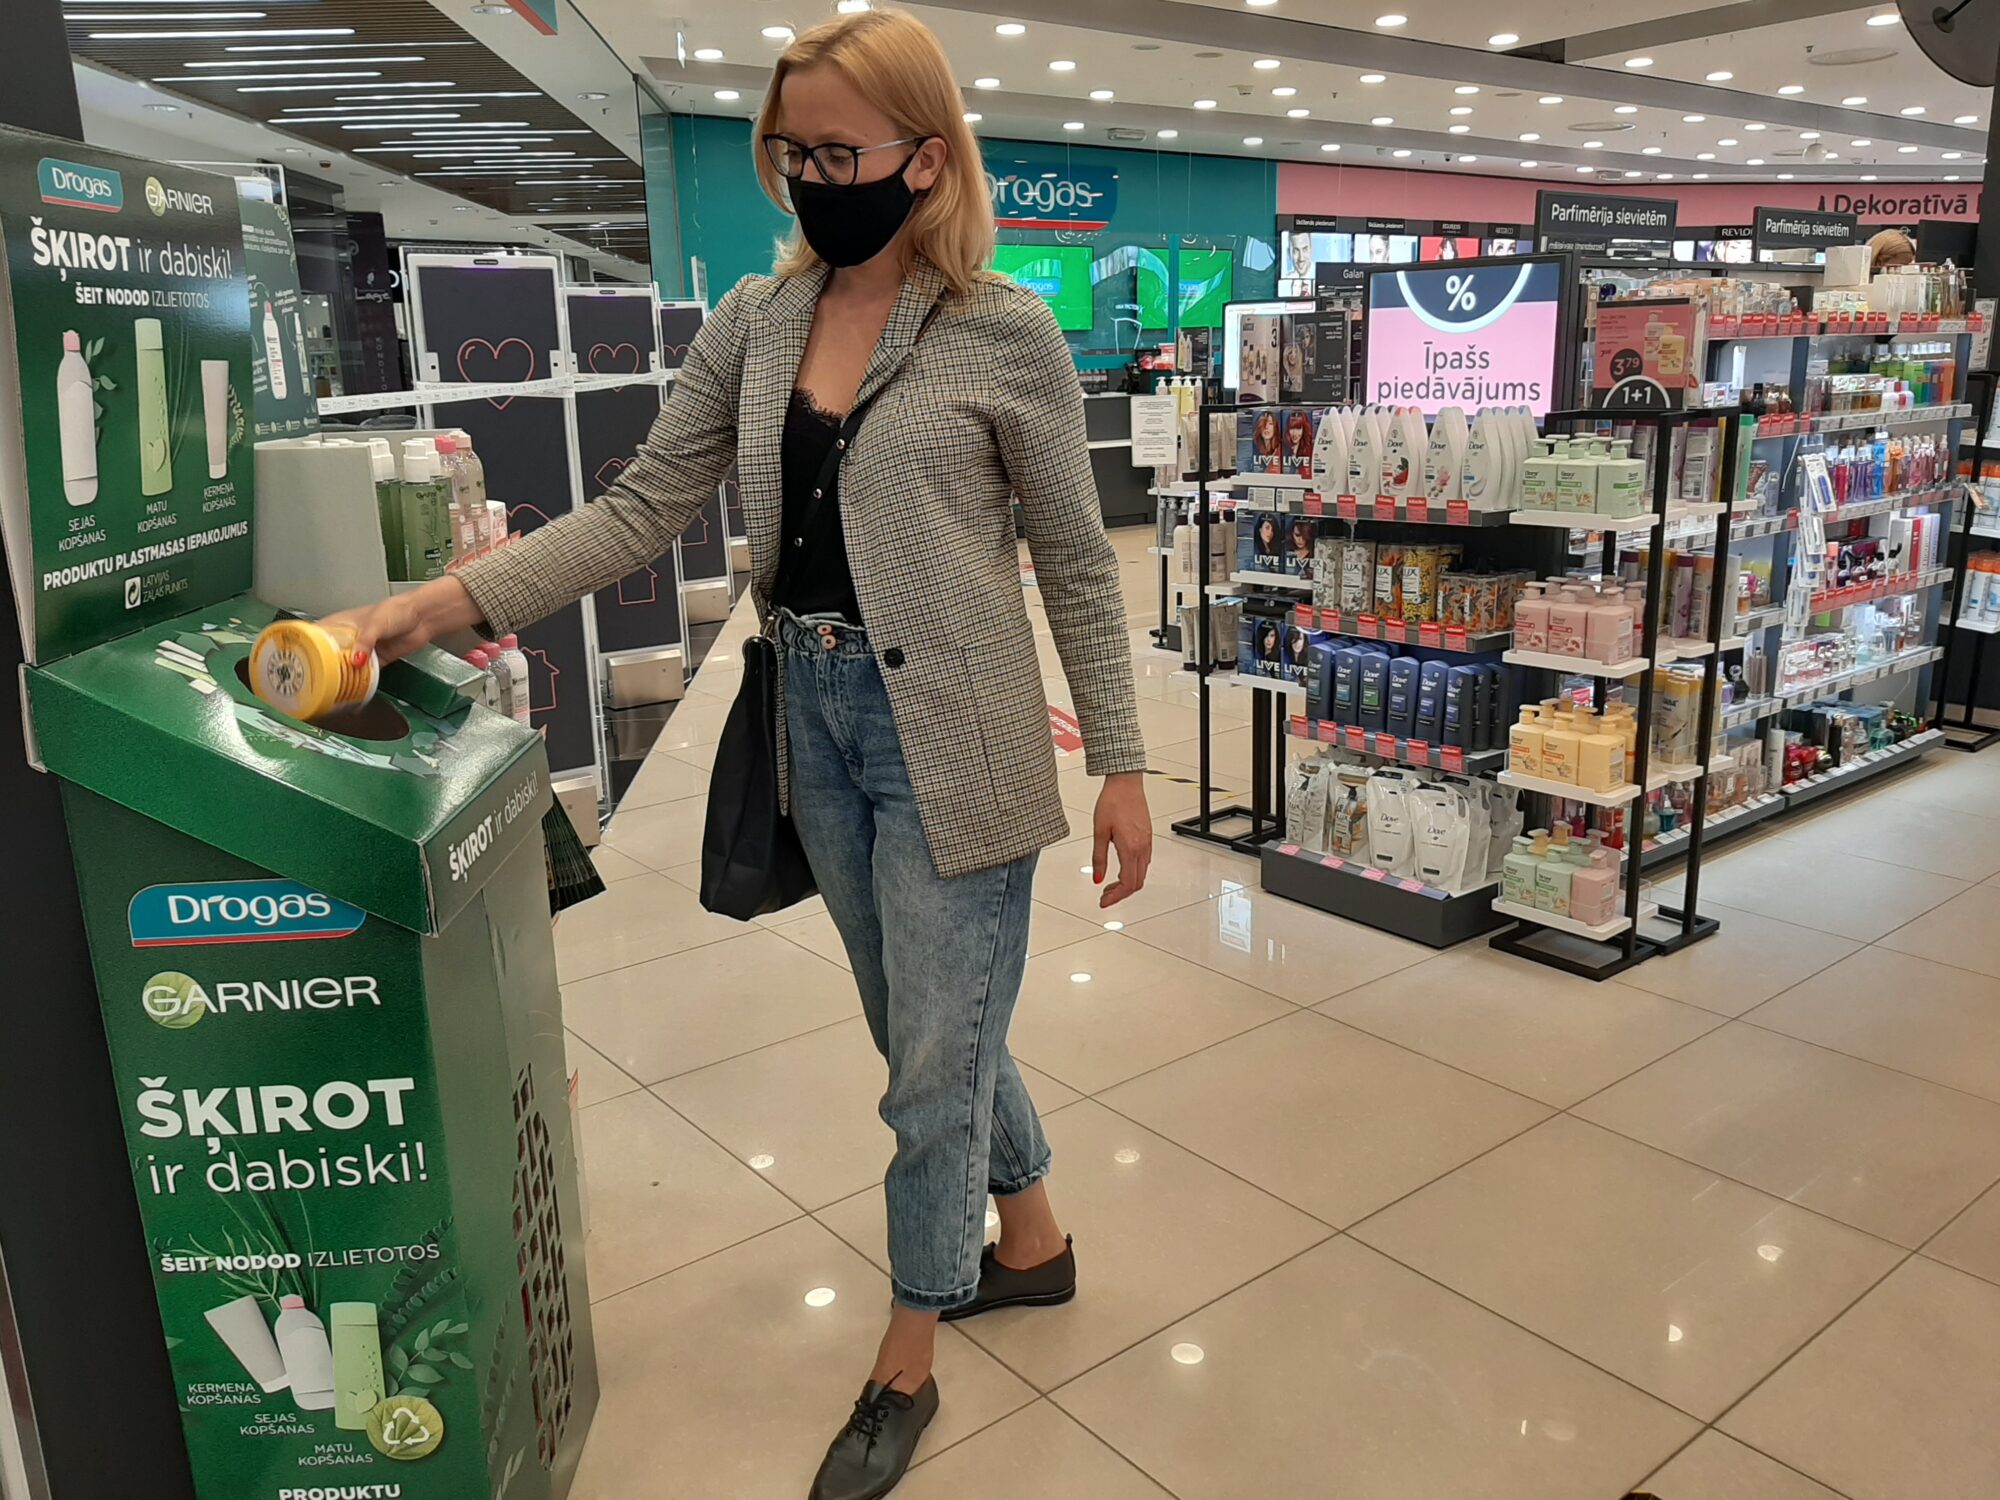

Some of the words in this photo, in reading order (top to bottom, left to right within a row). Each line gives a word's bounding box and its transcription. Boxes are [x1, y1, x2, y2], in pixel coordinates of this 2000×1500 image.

[52, 167, 112, 198] Drogas
[1834, 194, 1968, 215] Dekoratīvā
[1551, 203, 1613, 226] Parfimērija
[1615, 208, 1667, 226] sievietēm
[1721, 228, 1753, 238] REVLO
[1765, 218, 1810, 237] Parfimērija
[1811, 222, 1849, 238] sievietēm
[30, 216, 131, 281] ŠĶIROT
[137, 238, 152, 273] ir
[160, 241, 233, 279] dabiski!
[75, 281, 103, 304] ŠEIT
[106, 288, 149, 306] NODOD
[152, 290, 210, 309] IZLIETOTOS
[1445, 274, 1476, 311] %
[1423, 341, 1490, 374] Īpašs
[1378, 376, 1541, 405] piedāvājums
[1622, 385, 1652, 404] 1+1
[1430, 442, 1447, 450] Dove
[1468, 442, 1485, 450] Dove
[1253, 455, 1279, 466] LIVE
[1282, 456, 1309, 467] LIVE
[146, 500, 167, 515] MATU
[202, 495, 236, 513] KOPŠANAS
[68, 515, 96, 532] SEJAS
[137, 513, 177, 533] KOPŠANAS
[58, 529, 106, 552] KOPŠANAS
[43, 556, 113, 591] PRODUKTU
[116, 538, 185, 571] PLASTMASAS
[187, 521, 248, 550] IEPAKOJUMUS
[1254, 554, 1279, 566] LIVE
[1256, 659, 1280, 672] LIVE
[1284, 664, 1307, 676] LIVE
[1380, 812, 1399, 822] Dove
[448, 815, 494, 883] ŠĶIROT
[493, 809, 503, 836] ir
[504, 770, 539, 824] dabiski!
[167, 893, 331, 926] Drogas
[136, 1076, 415, 1155] ŠĶIROT
[147, 1154, 184, 1195] ir
[206, 1141, 428, 1194] dabiski!
[160, 1253, 209, 1273] ŠEIT
[216, 1253, 301, 1272] NODOD
[307, 1243, 440, 1268] IZLIETOTOS
[187, 1393, 261, 1405] KOPŠANAS
[188, 1383, 255, 1398] ĶERMEŅA
[254, 1413, 296, 1424] SEJAS
[240, 1423, 315, 1436] KOPŠANAS
[314, 1443, 353, 1454] MATU
[298, 1453, 373, 1466] KOPŠANAS
[278, 1484, 401, 1500] PRODUKTU
